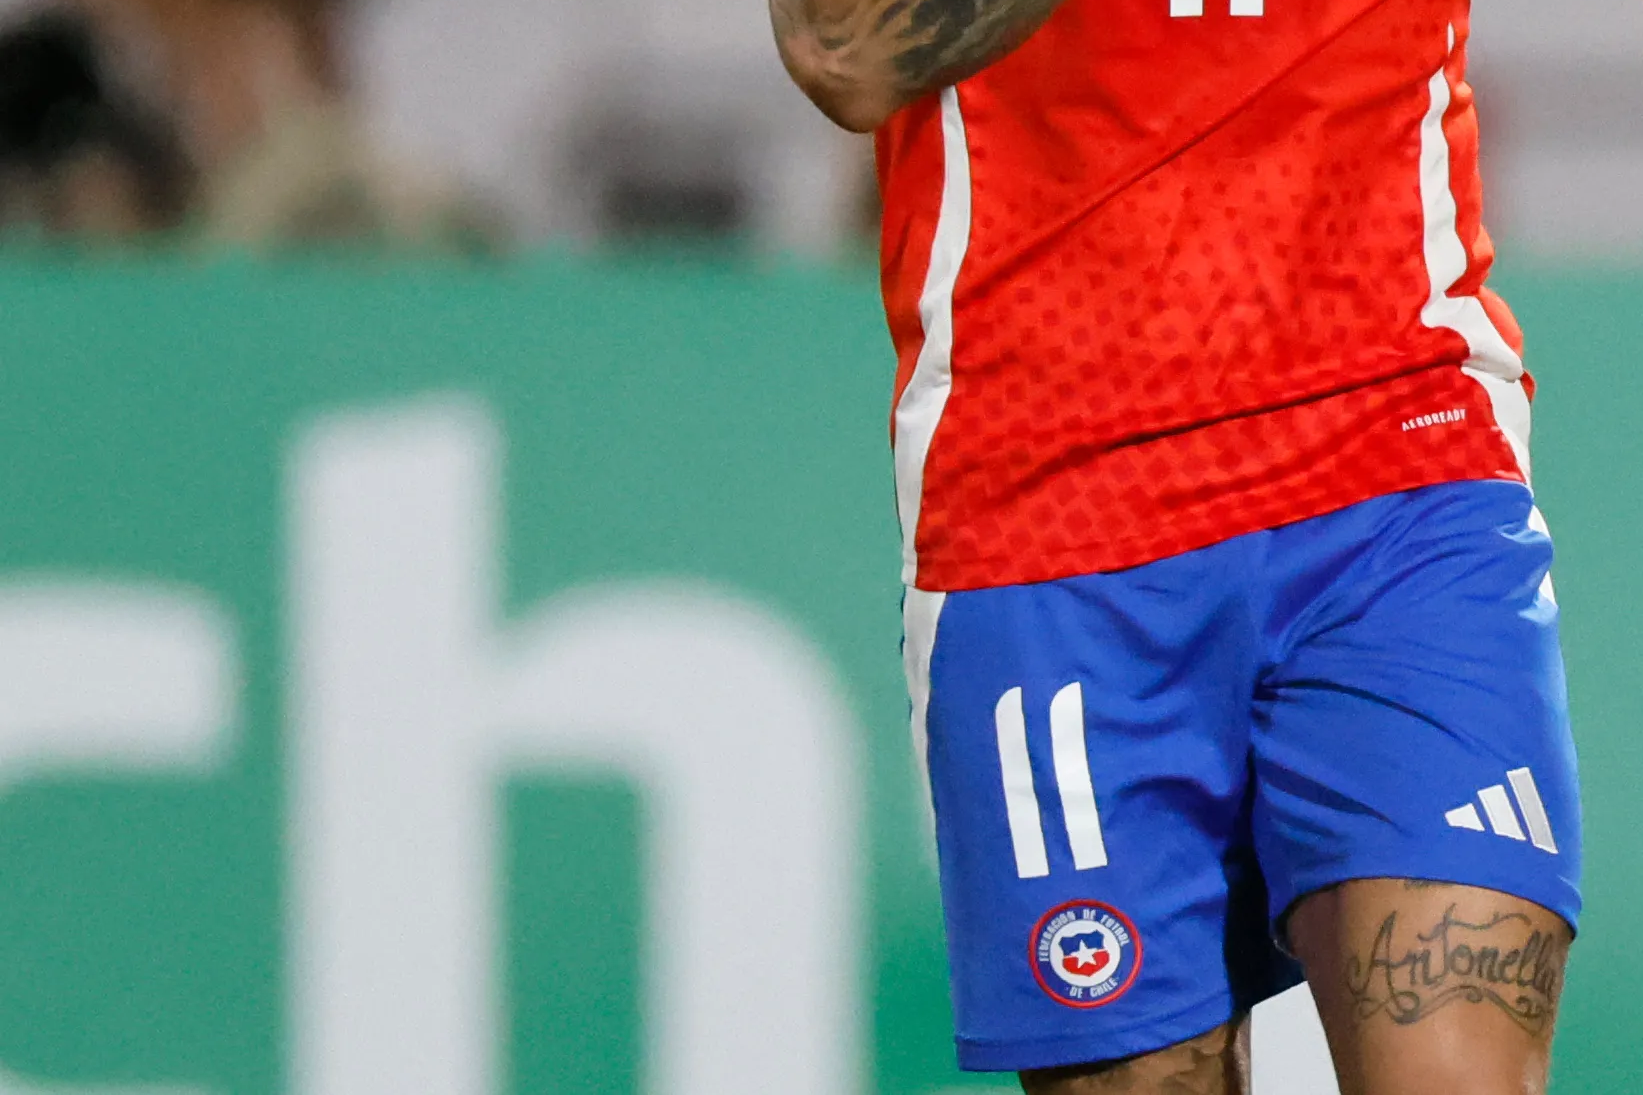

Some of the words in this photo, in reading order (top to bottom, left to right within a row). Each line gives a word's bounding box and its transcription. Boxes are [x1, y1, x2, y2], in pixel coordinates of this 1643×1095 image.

[1401, 408, 1466, 432] AEROREADY
[995, 681, 1108, 879] 11
[1082, 908, 1097, 920] DE
[1100, 914, 1130, 946] FUTBOL
[1069, 986, 1083, 998] DE
[1089, 977, 1118, 998] CHILE
